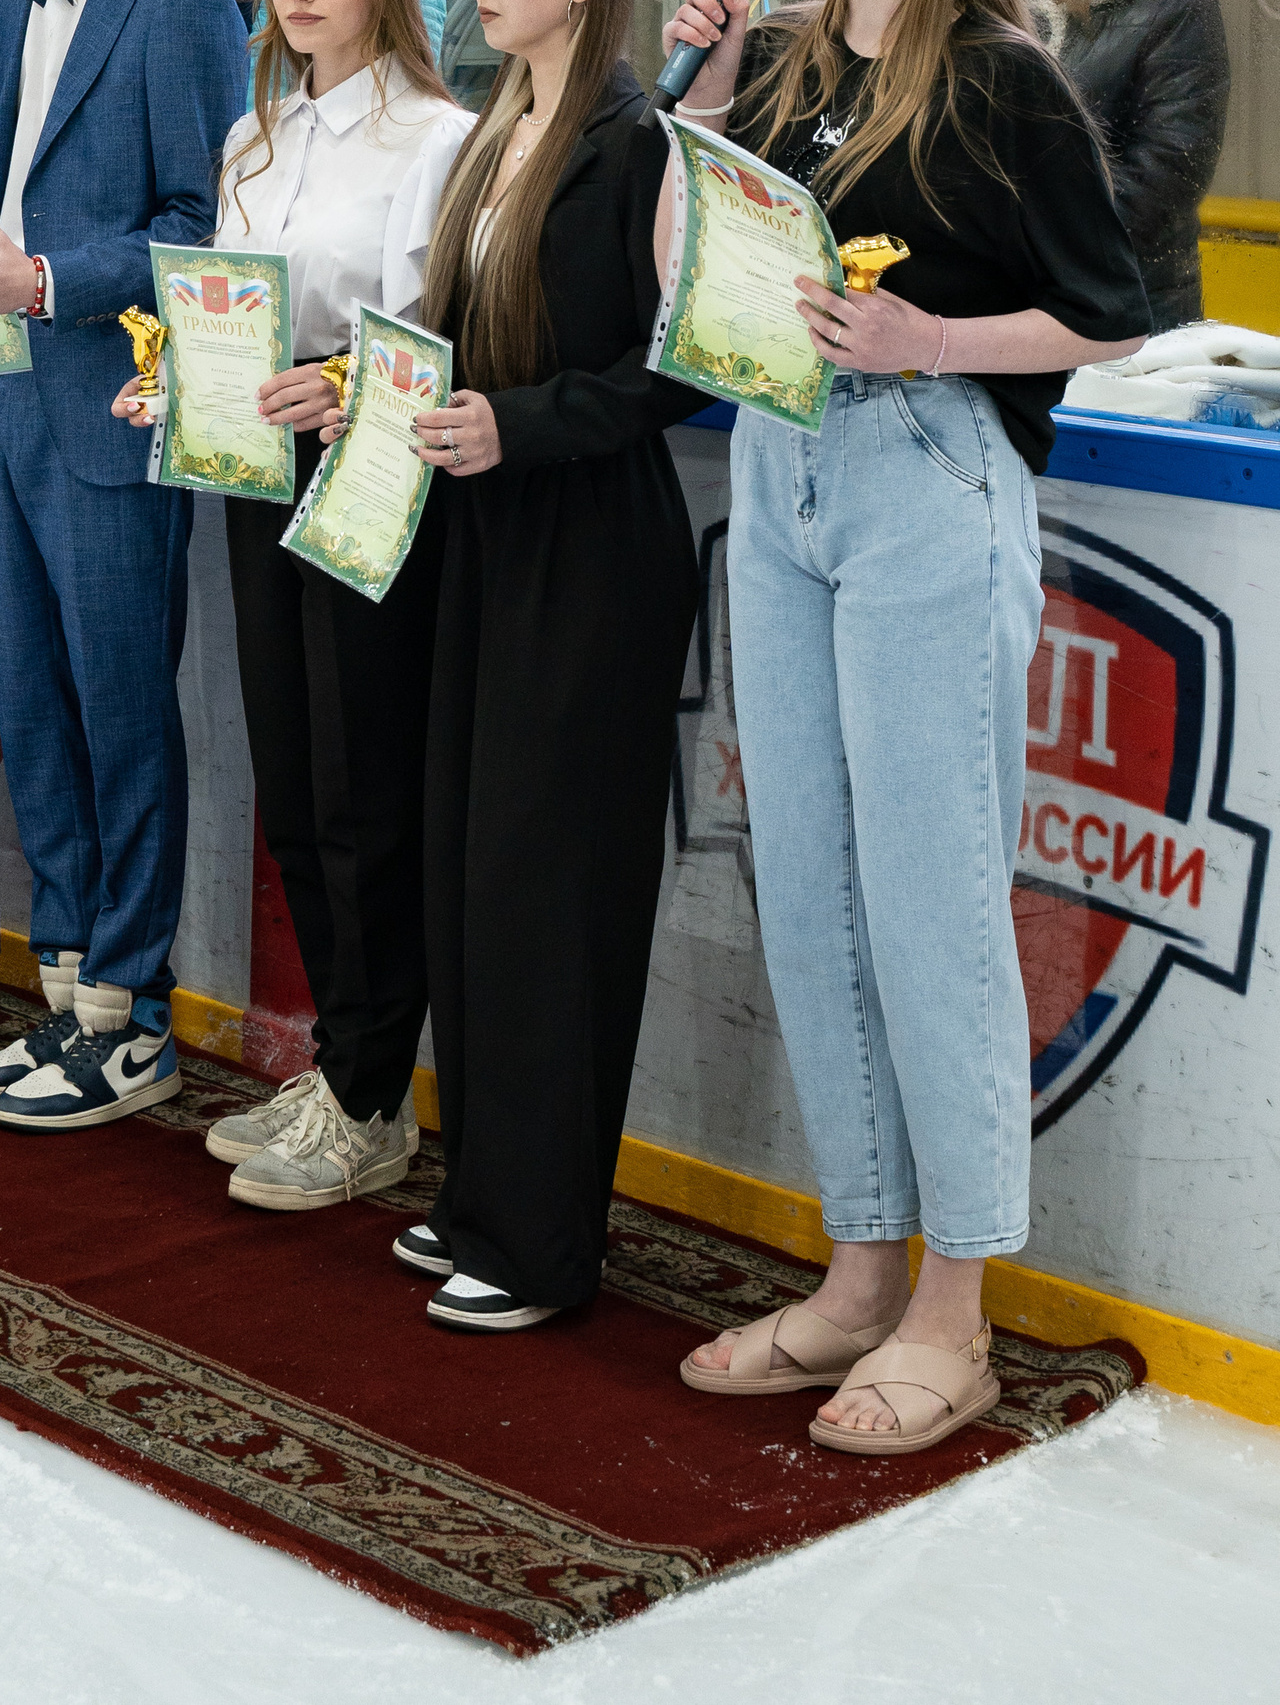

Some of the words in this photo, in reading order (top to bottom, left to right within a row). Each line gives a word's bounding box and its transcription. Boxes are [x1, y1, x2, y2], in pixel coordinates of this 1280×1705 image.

[718, 191, 807, 243] ГРАМОТА
[182, 315, 258, 338] ГРАМОТА
[371, 386, 418, 421] ГРАМОТ
[1019, 800, 1206, 910] ССИИ
